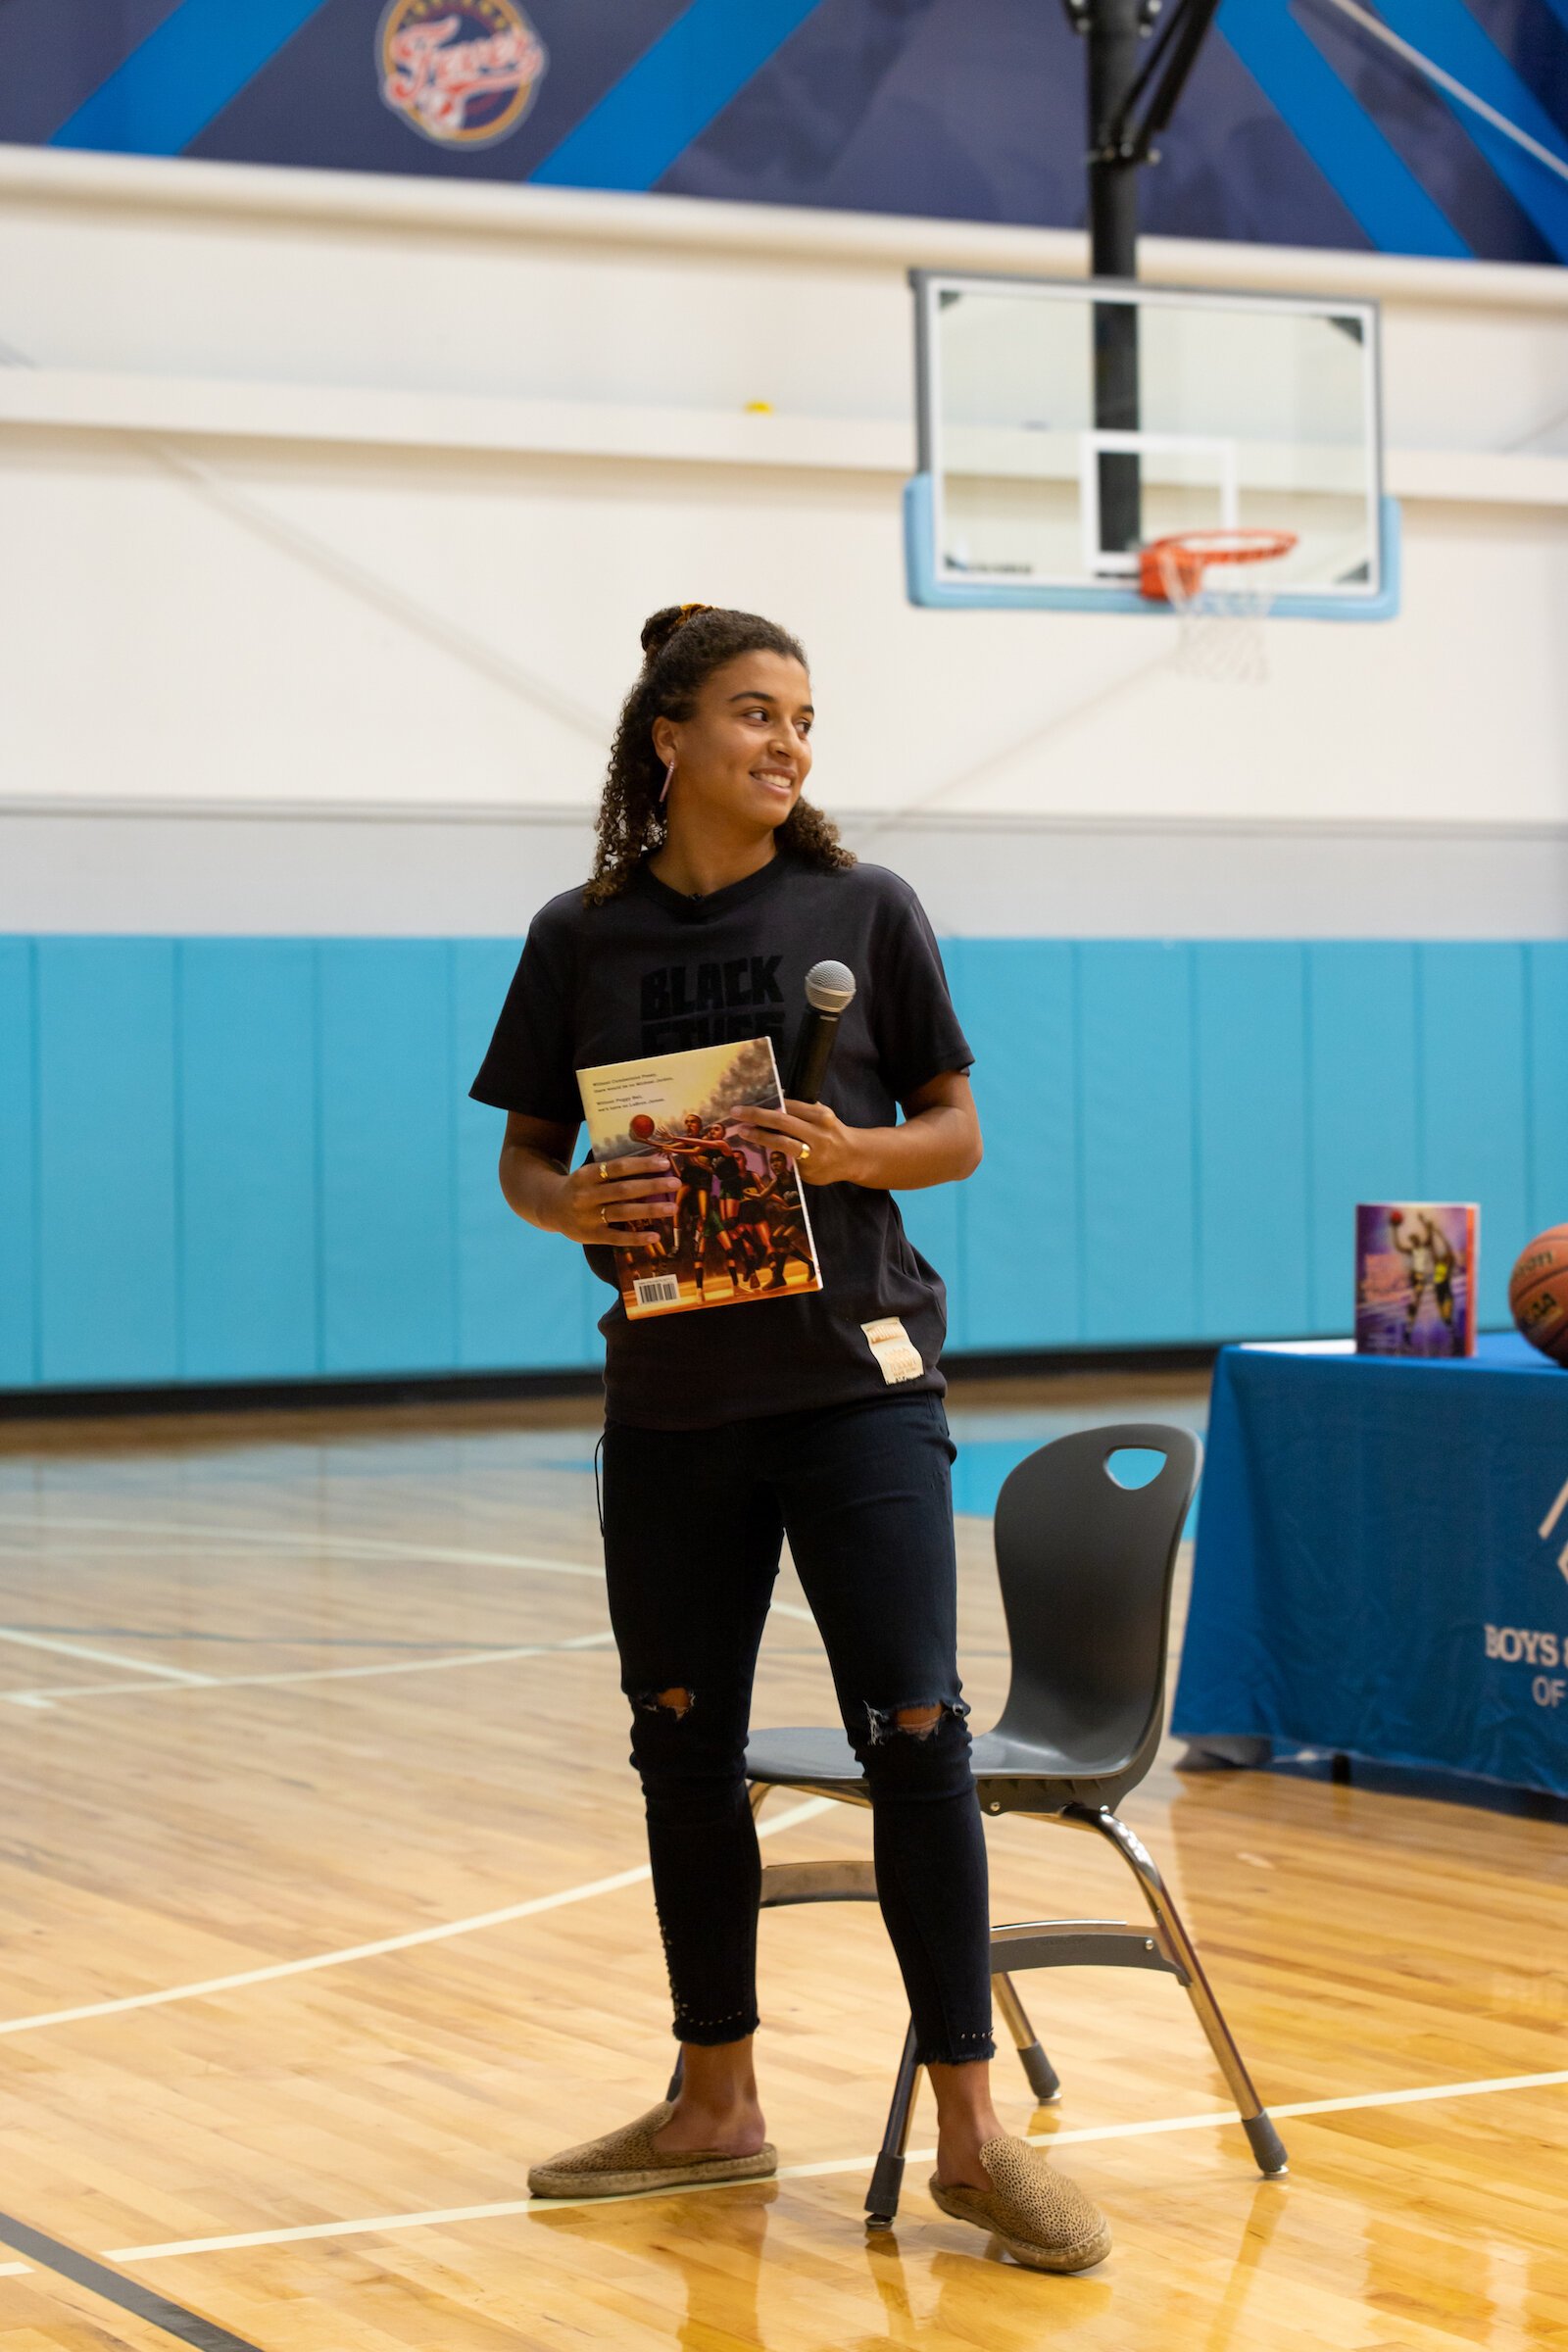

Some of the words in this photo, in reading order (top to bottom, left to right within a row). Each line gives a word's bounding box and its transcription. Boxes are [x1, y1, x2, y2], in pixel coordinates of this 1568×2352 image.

[640, 955, 785, 1021] BLACK
[1484, 1623, 1559, 1667] BOYS
[1532, 1675, 1566, 1708] OF
